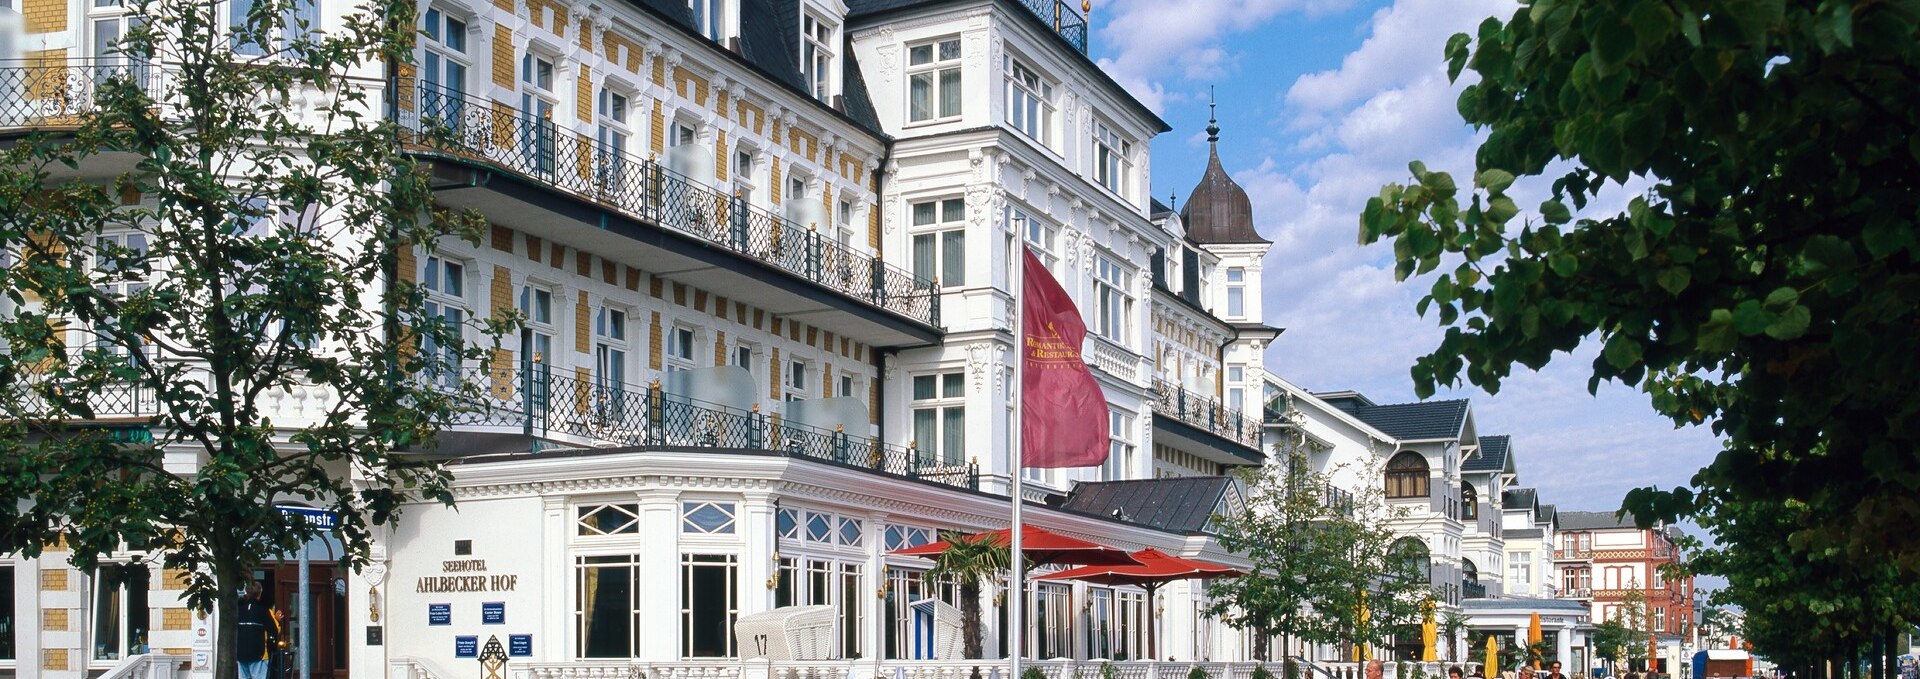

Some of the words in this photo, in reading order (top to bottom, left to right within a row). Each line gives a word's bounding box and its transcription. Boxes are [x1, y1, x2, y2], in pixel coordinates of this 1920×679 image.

[442, 559, 487, 572] SEEHOTEL
[416, 575, 487, 593] AHLBECKER
[490, 574, 518, 592] HOF
[754, 634, 767, 655] 17
